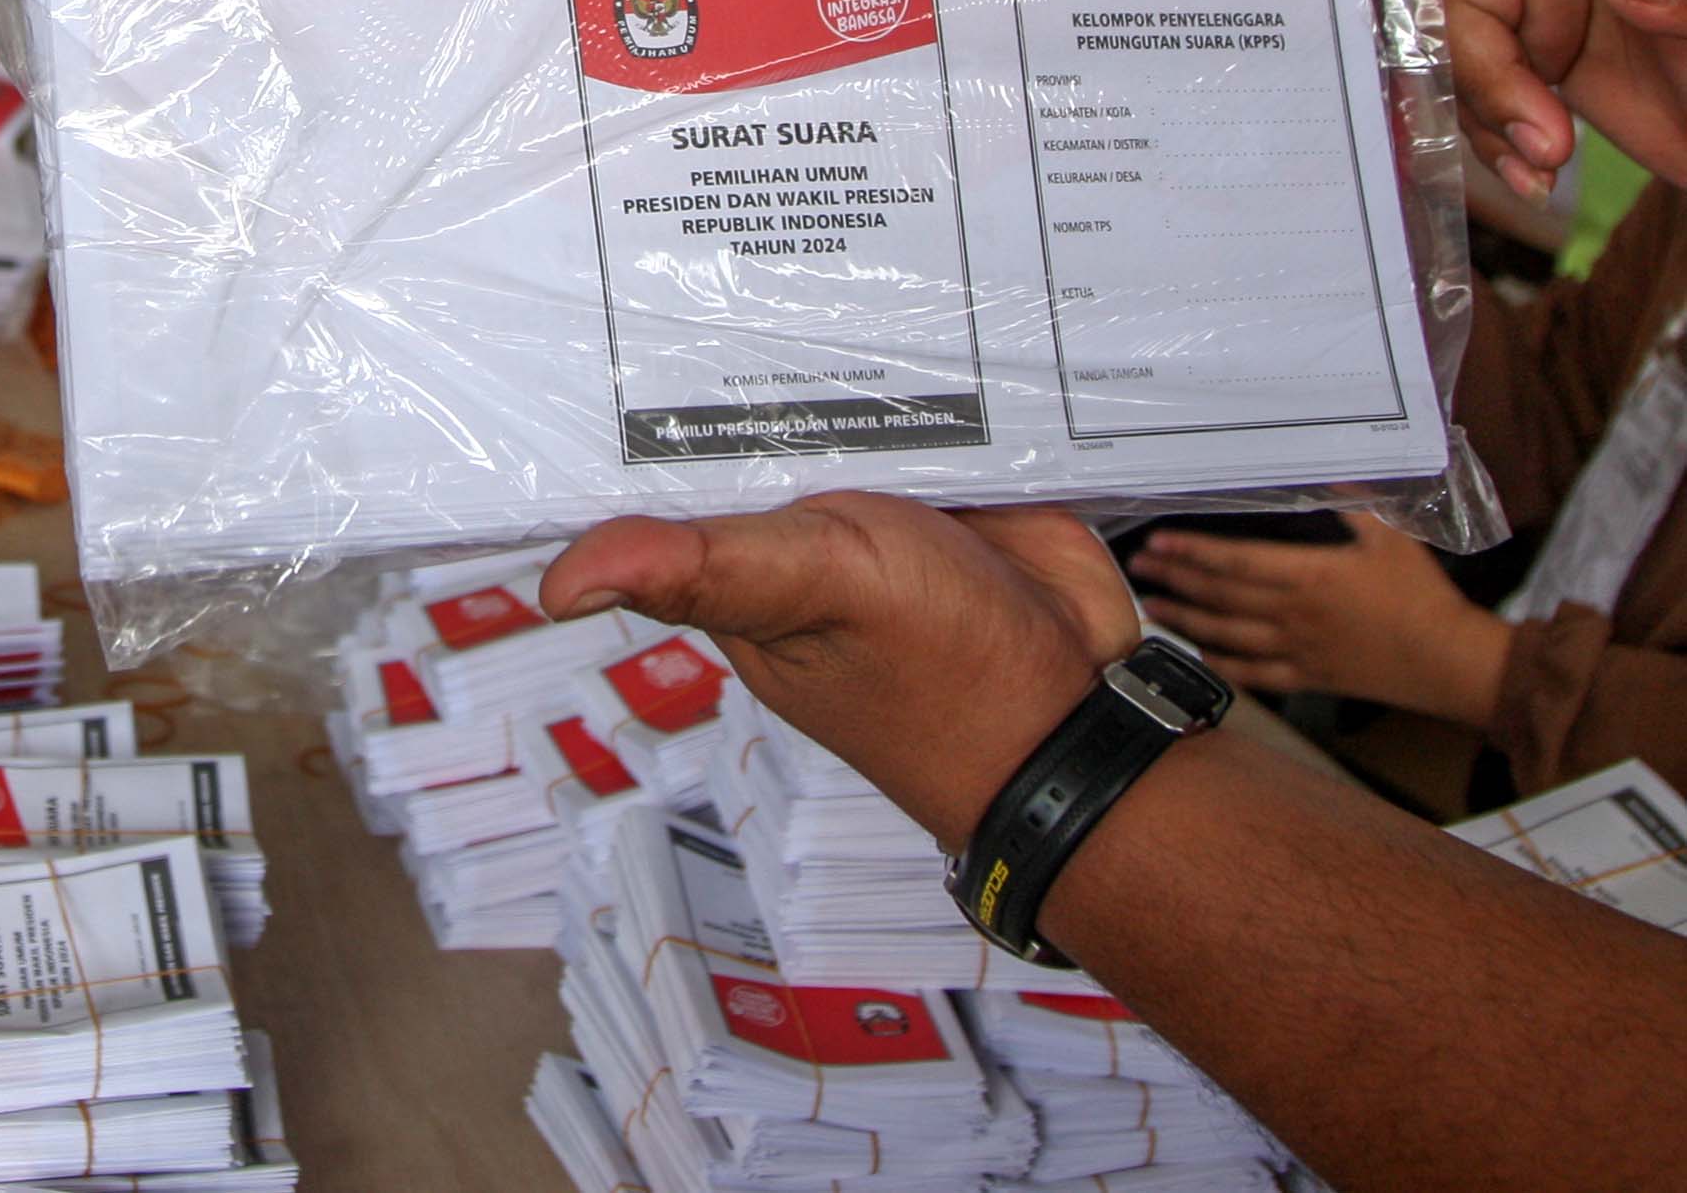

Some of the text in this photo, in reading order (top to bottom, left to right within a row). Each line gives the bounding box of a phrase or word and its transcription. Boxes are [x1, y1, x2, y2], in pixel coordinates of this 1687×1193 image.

[836, 6, 896, 33] BANGSA
[1071, 12, 1285, 28] KELOMPOK PENYELENGGARA
[1076, 34, 1286, 51] PEMUNGUTAN SUARA (KPPS)
[1105, 106, 1132, 118] KOTA
[671, 120, 878, 150] SURAT SUARA
[1043, 138, 1106, 151] KECAMATAN
[1113, 138, 1152, 150] DISTRIK
[690, 165, 868, 187] PEMILIHAN UMUM
[1047, 171, 1108, 184] KELURAHAN
[1115, 170, 1143, 183] DESA
[622, 187, 935, 214] PRESIDEN DAN WAKIL PRESIDEN
[681, 212, 888, 235] REPUBLIK INDONESIA
[1053, 220, 1113, 233] NOMOR TPS
[729, 237, 848, 257] TAHUN 2024
[1061, 287, 1095, 299] KETUA
[723, 369, 886, 388] KOMISI PEMILIHAN UMUM
[1072, 367, 1154, 382] TANDA TANGAN
[795, 417, 829, 433] DAN
[831, 415, 882, 431] WAKIL
[884, 411, 955, 427] PRESIDEN
